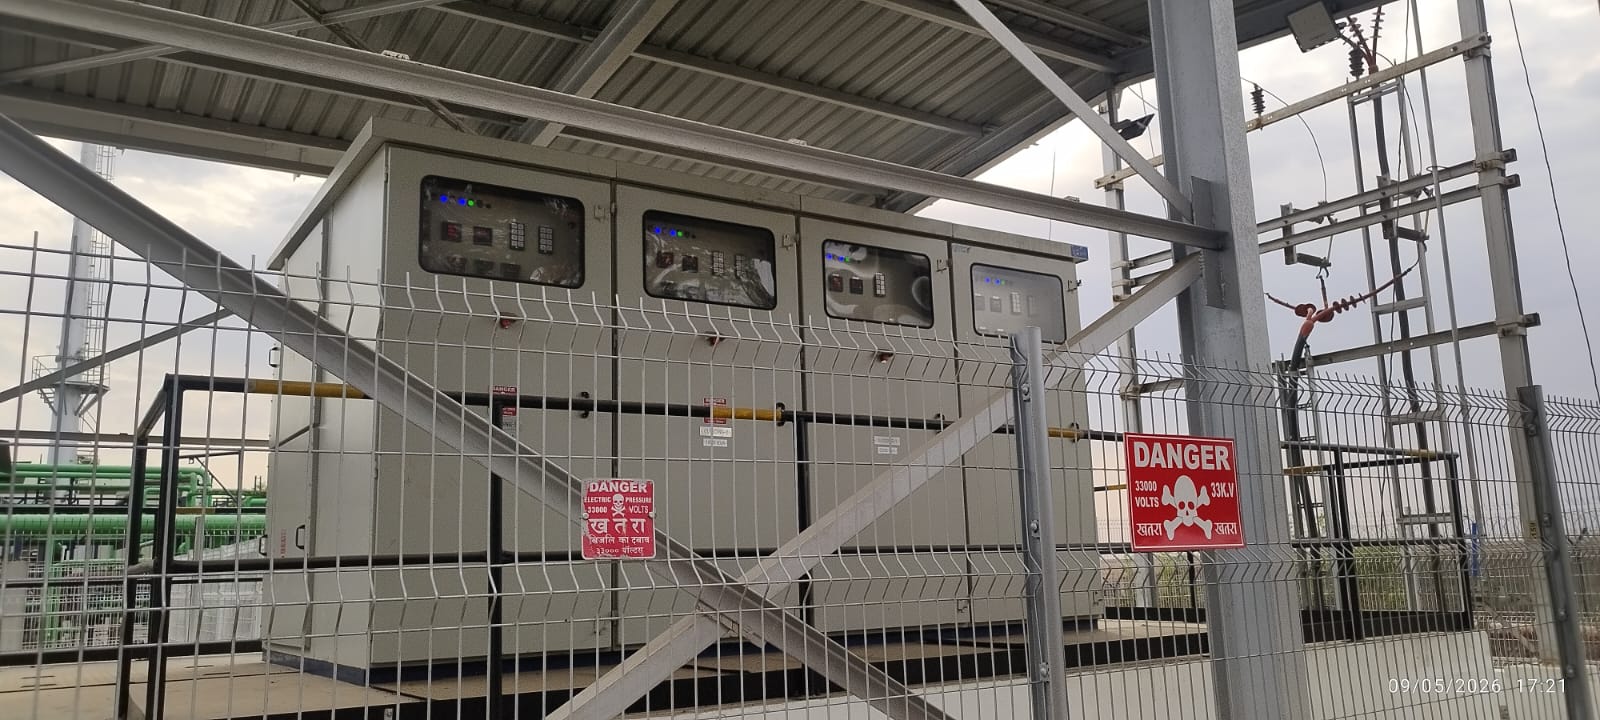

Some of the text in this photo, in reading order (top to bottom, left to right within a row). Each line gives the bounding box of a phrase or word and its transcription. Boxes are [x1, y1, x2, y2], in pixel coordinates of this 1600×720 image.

[1133, 441, 1231, 471] DANGER
[589, 481, 648, 493] DANGER
[1135, 480, 1157, 492] 33000
[1210, 482, 1234, 498] 33K.V
[1135, 496, 1160, 508] VOLTS
[587, 505, 649, 514] 33000 VOLTS
[1136, 522, 1237, 537] खतरा खतरा
[618, 536, 629, 544] का
